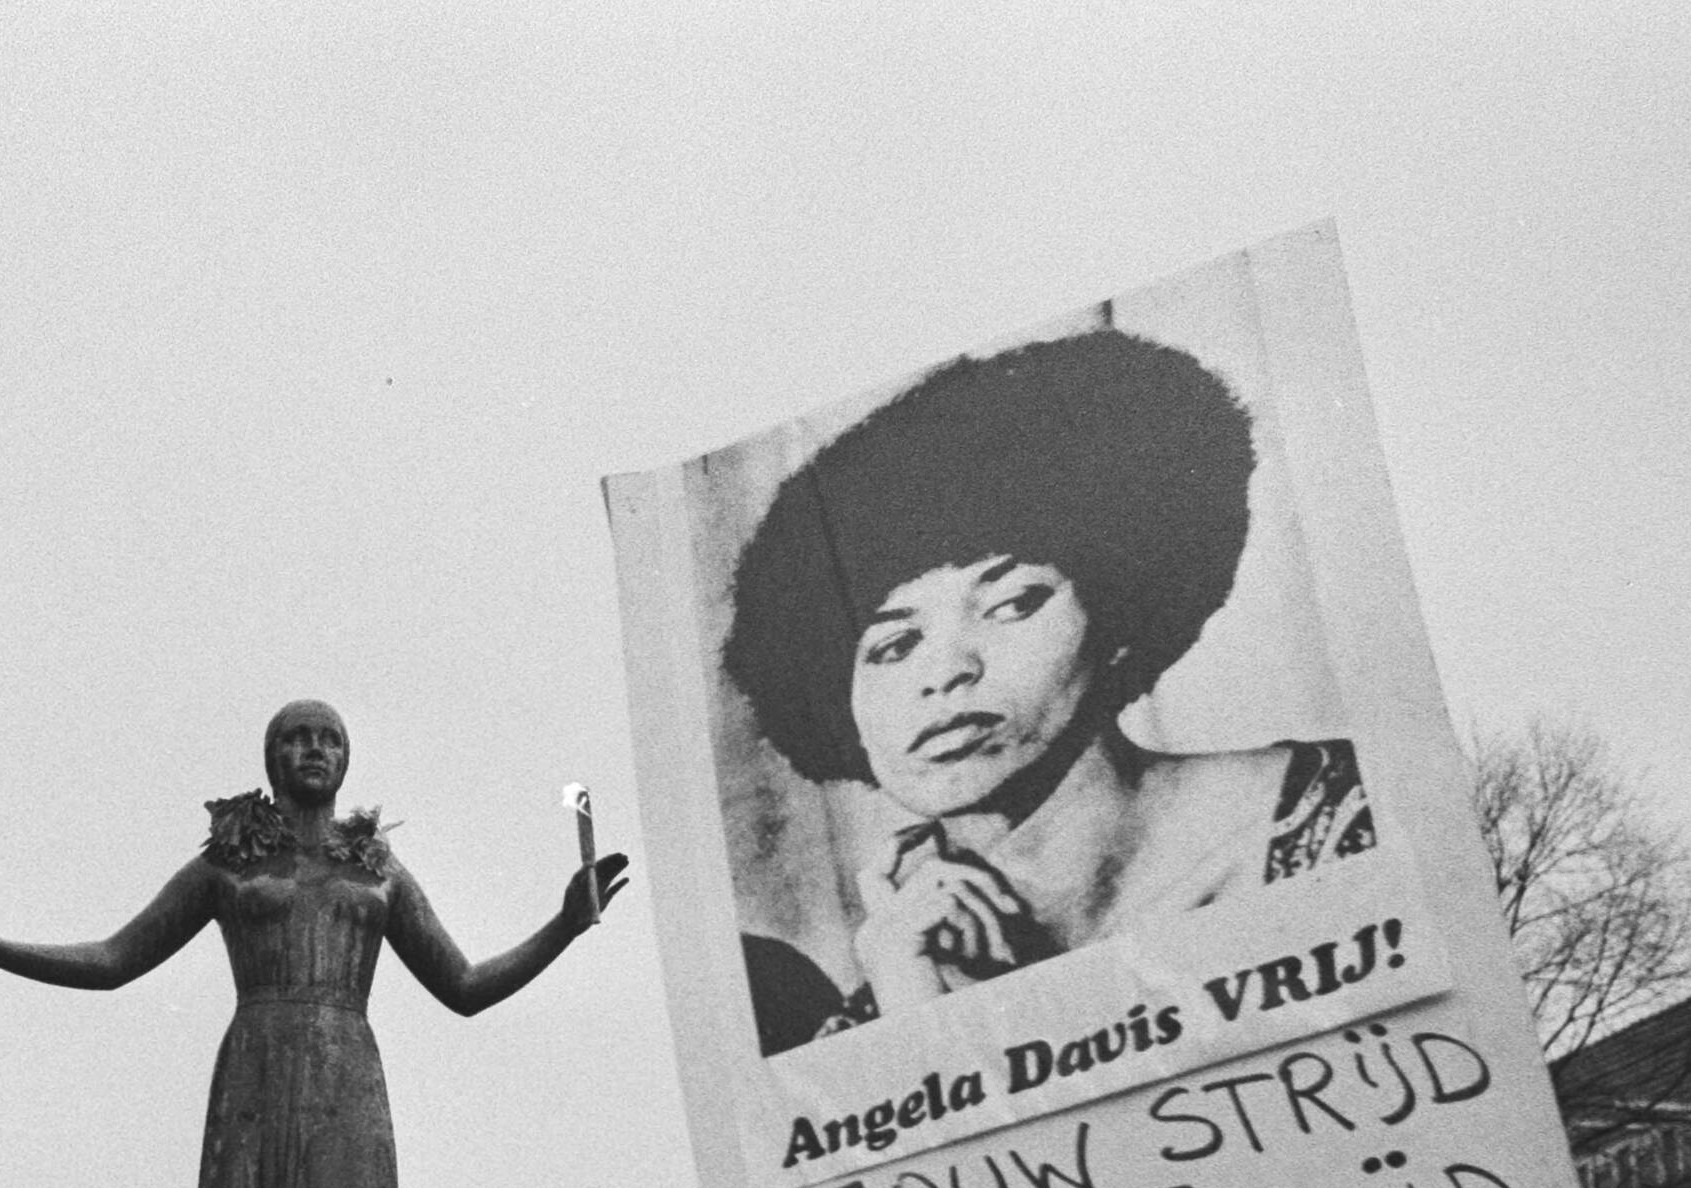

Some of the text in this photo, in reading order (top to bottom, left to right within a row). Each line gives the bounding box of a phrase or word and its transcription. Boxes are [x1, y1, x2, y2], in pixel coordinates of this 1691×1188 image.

[781, 918, 1406, 1169] Angela Davis VRIJ!
